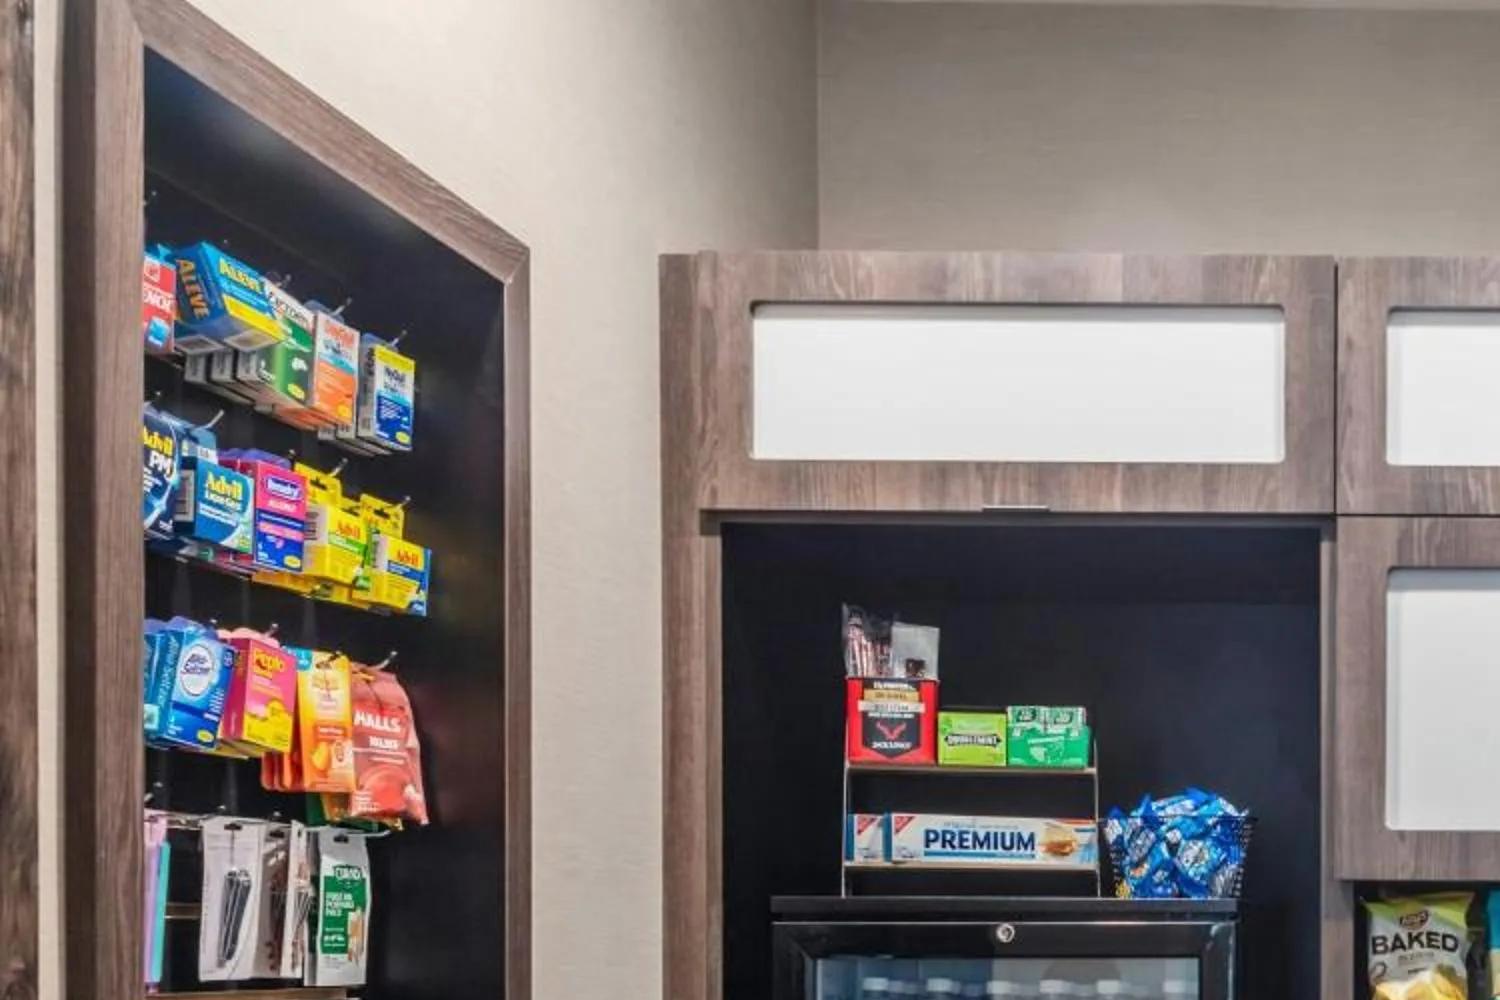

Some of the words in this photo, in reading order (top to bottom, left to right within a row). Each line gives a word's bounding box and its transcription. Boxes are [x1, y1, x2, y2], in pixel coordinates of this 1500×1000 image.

[207, 471, 243, 499] Advil
[354, 711, 401, 732] HALLS
[924, 829, 1036, 851] PREMIUM
[1371, 931, 1459, 956] BAKED
